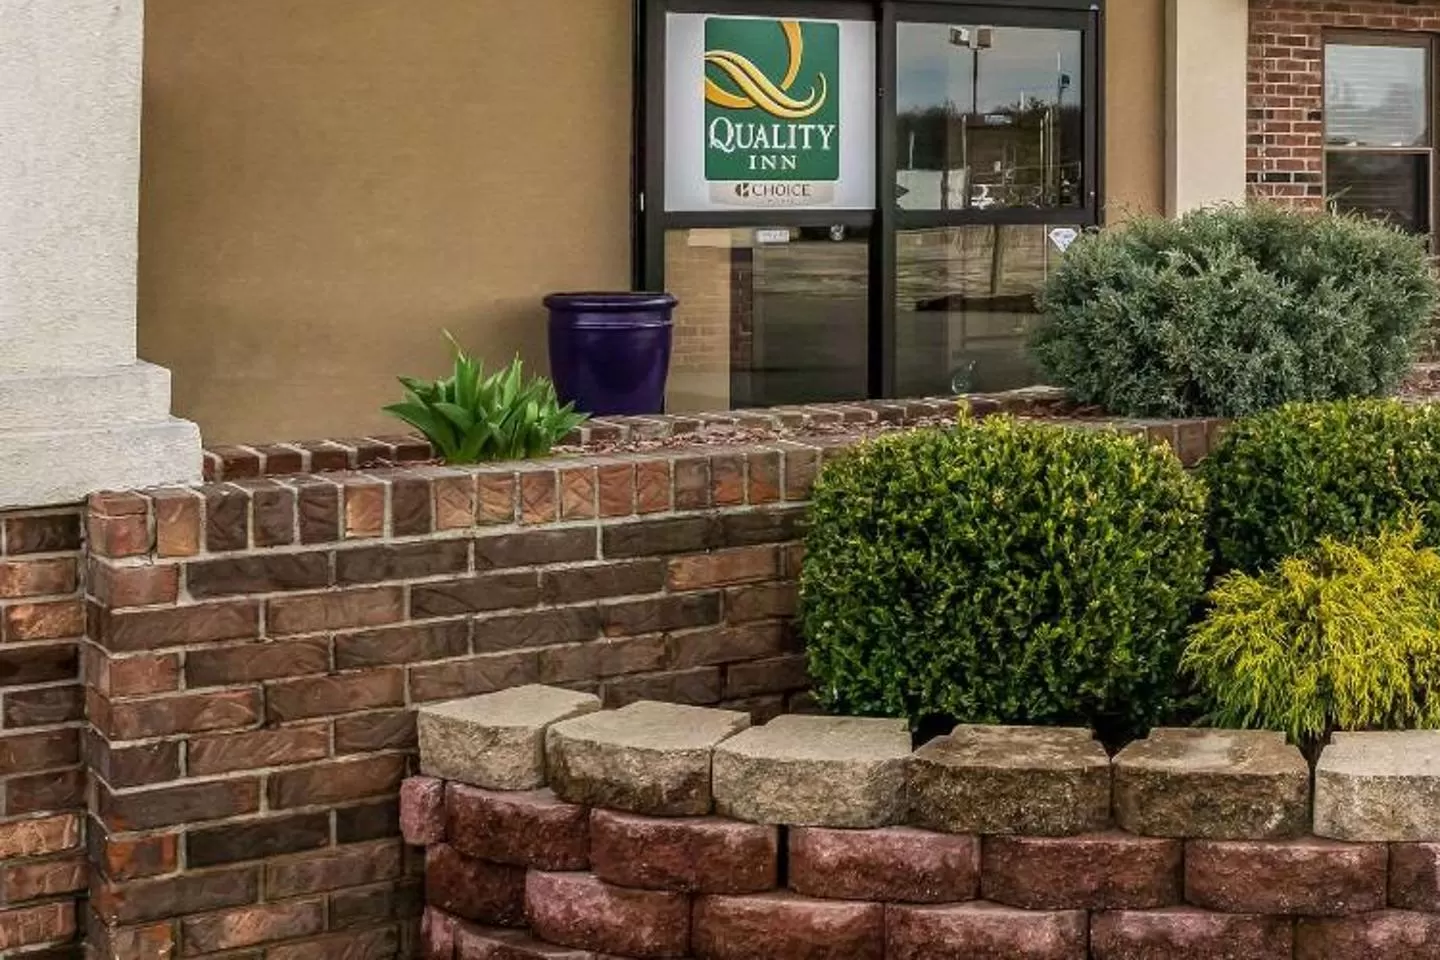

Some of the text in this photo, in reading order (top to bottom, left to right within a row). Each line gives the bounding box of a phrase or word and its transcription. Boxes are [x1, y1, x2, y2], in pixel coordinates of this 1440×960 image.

[709, 116, 835, 153] QUALITY
[748, 155, 797, 170] INN
[752, 183, 811, 197] CHOICE
